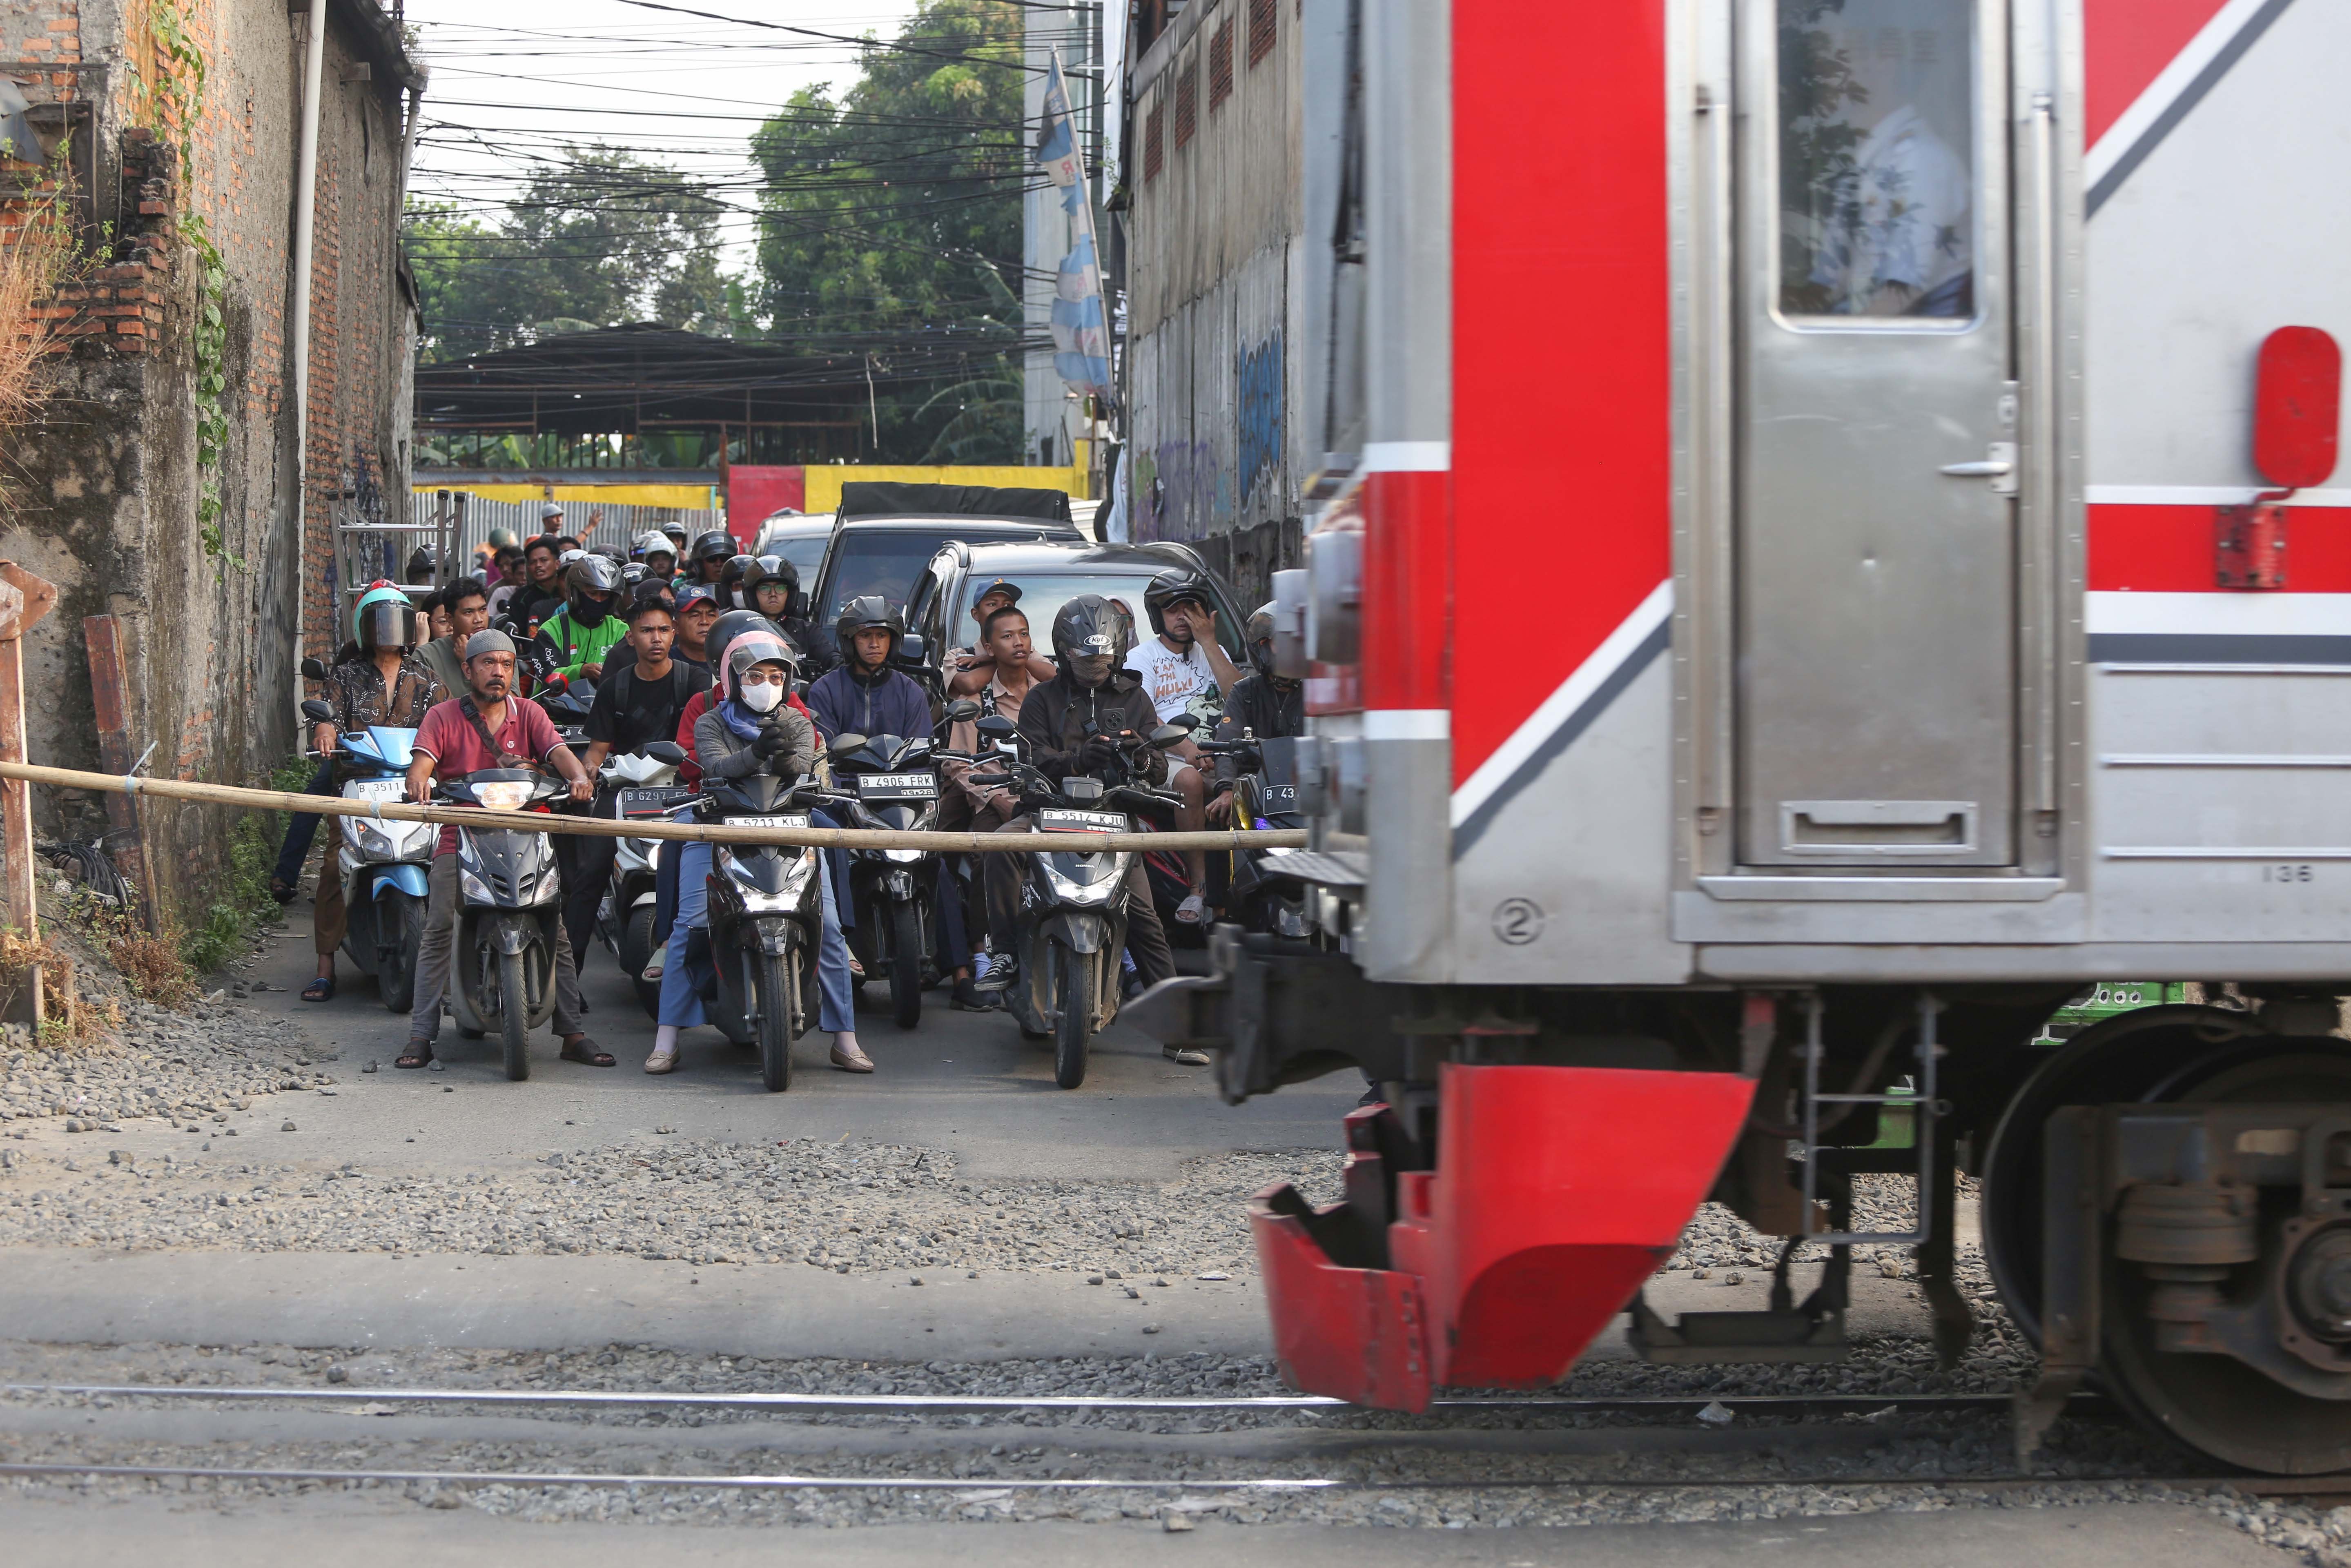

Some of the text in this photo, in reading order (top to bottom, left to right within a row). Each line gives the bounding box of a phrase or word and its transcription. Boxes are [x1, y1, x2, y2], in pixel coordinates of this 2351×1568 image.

[1163, 663, 1175, 671] AM
[1155, 677, 1193, 699] HULK!
[862, 776, 931, 787] B 4906 FRK
[359, 783, 399, 793] B 3511
[1266, 787, 1295, 800] B 43
[627, 791, 633, 801] B
[638, 791, 666, 801] 6297
[744, 818, 775, 826] 5711
[782, 818, 806, 826] KLJ
[1061, 812, 1091, 821] 5514
[1100, 815, 1123, 826] KJU
[1030, 883, 1041, 901] HONDA
